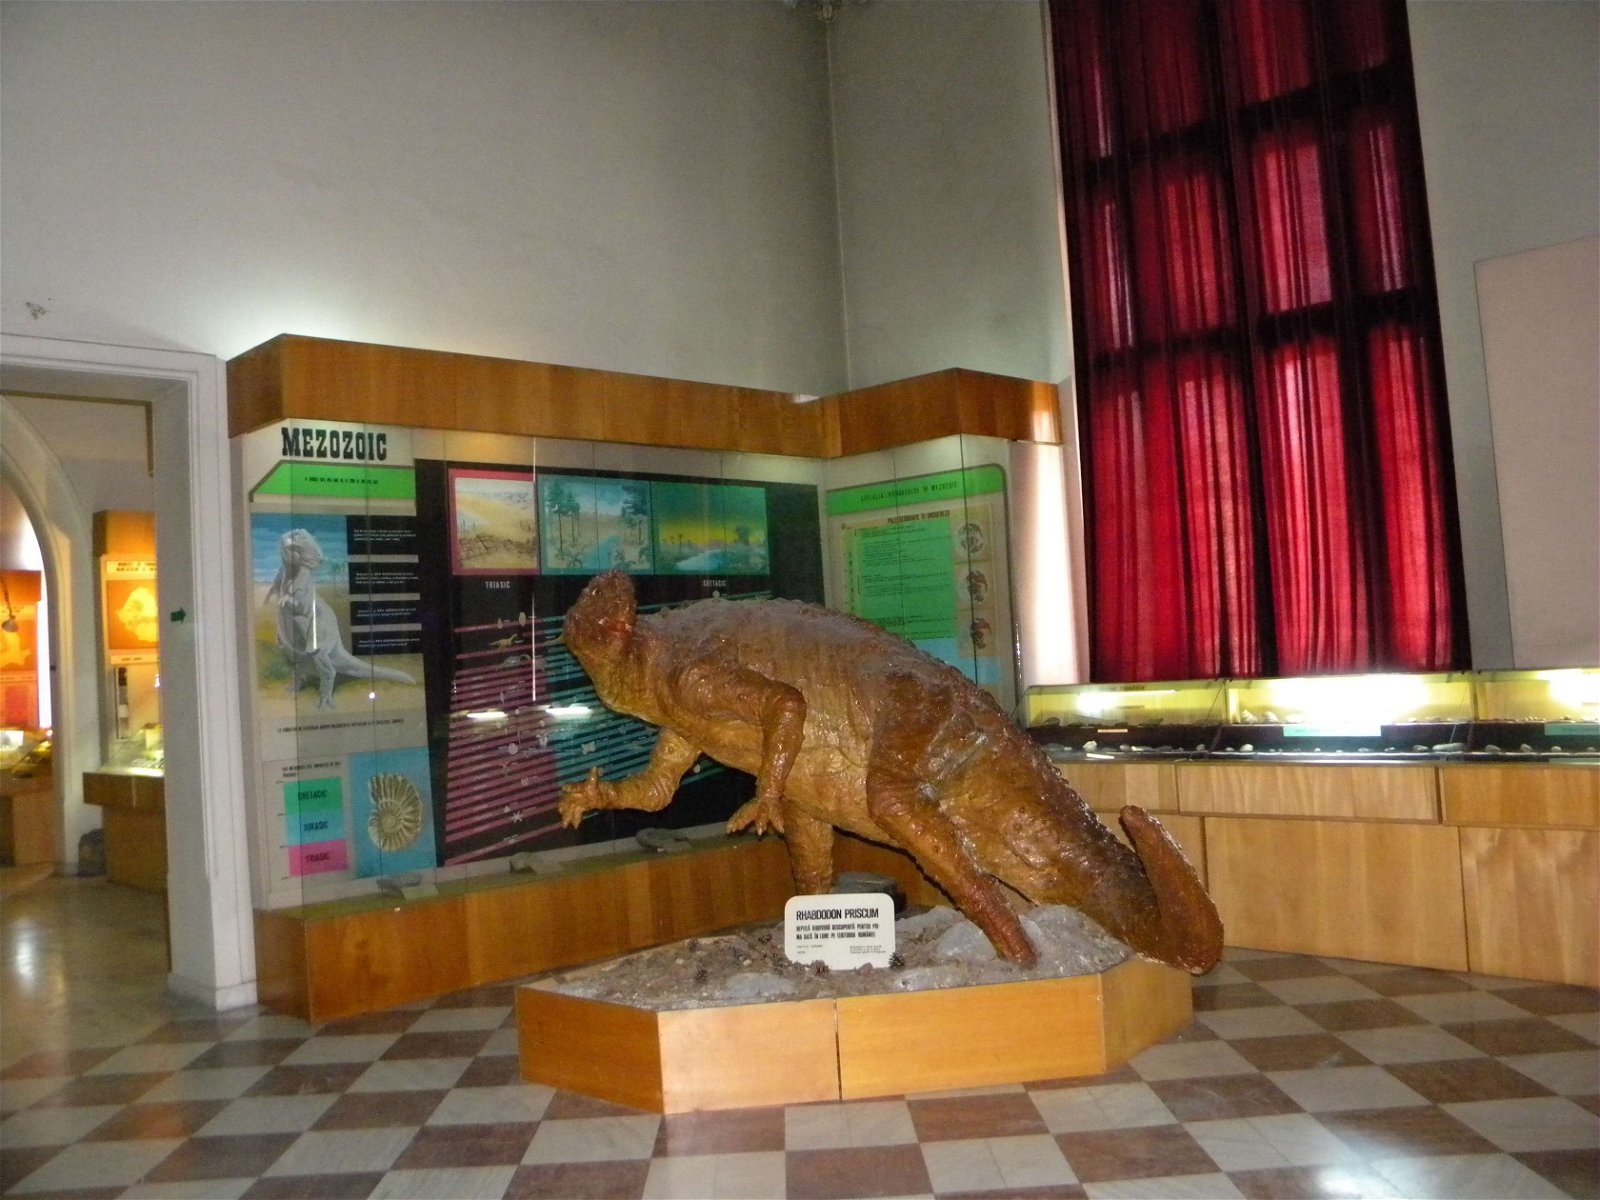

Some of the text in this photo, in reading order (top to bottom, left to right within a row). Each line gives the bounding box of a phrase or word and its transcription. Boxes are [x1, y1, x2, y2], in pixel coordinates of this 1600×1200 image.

[281, 427, 387, 461] MEZOZOIC
[485, 580, 511, 589] TRIASIC
[304, 821, 329, 832] JURASIC
[796, 908, 879, 921] RHABDODON PRISCUM
